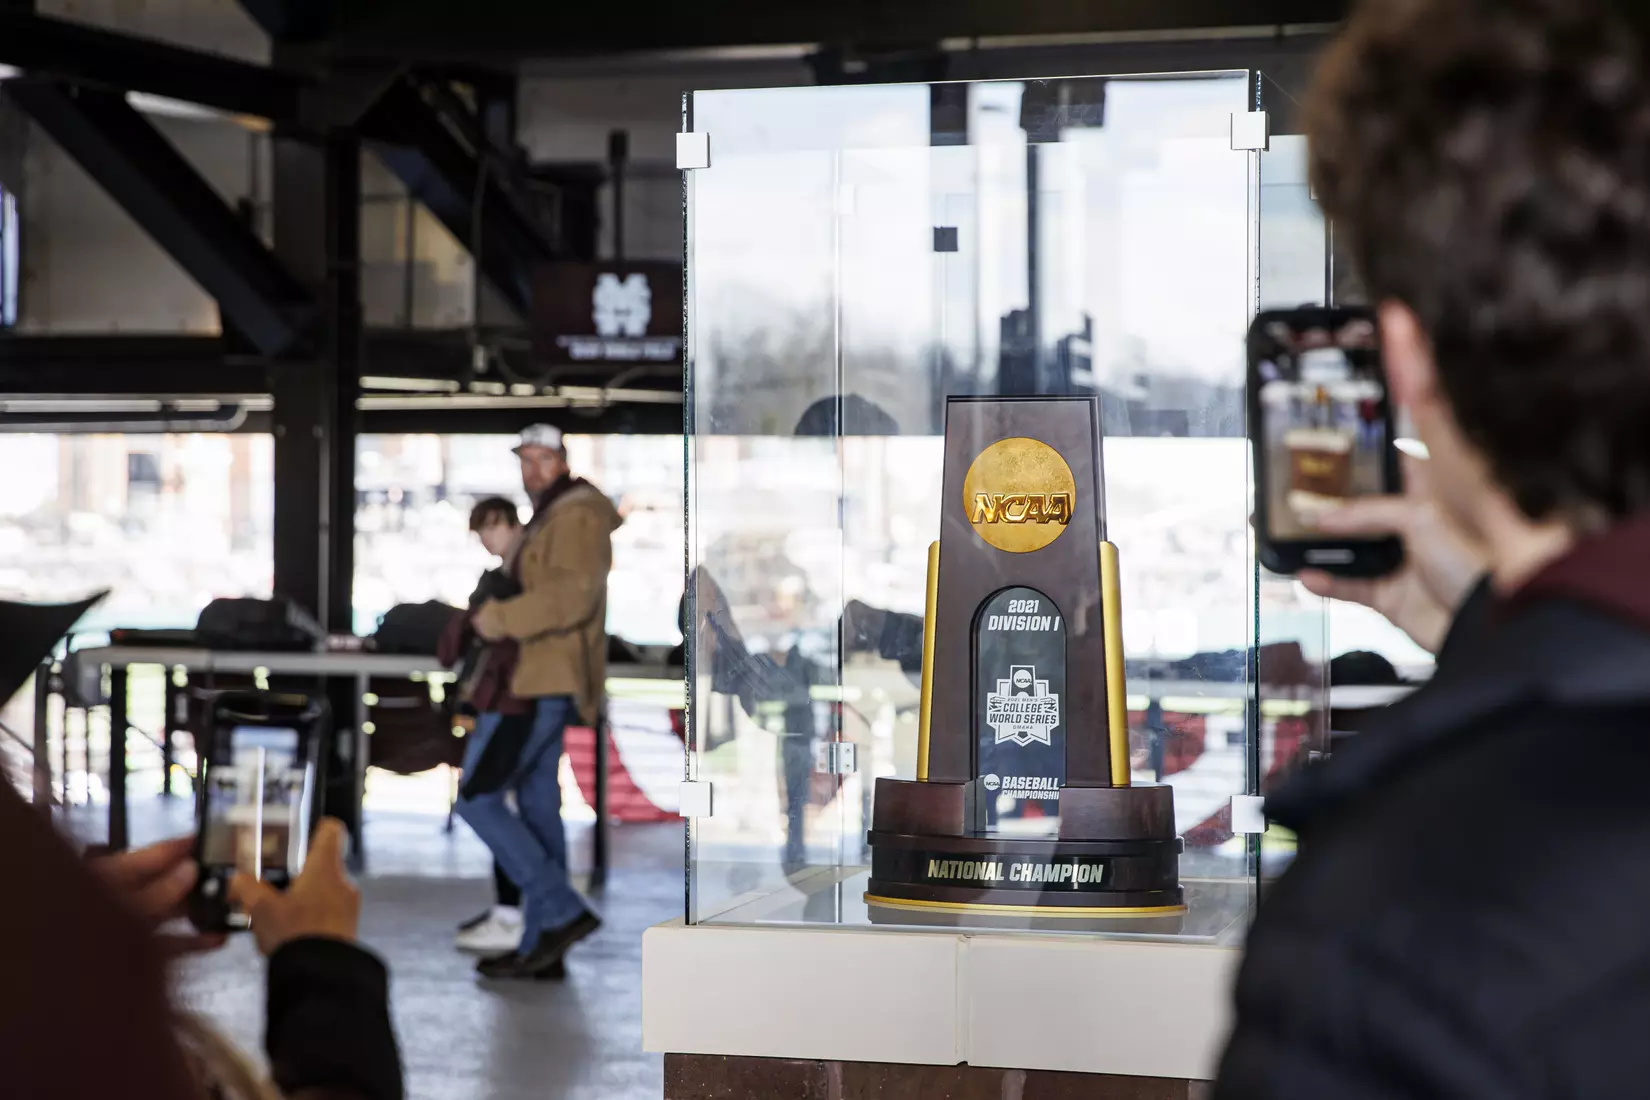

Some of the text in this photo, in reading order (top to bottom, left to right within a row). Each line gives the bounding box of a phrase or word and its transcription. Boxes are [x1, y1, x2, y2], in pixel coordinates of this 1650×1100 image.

[972, 493, 1072, 525] NCAA
[1008, 600, 1039, 614] 2021
[988, 615, 1060, 632] DIVISION I
[1003, 703, 1042, 713] COLLEGE
[989, 713, 1057, 725] WORLD SERIES
[1002, 776, 1060, 790] BASEBALL
[927, 859, 1104, 884] NATIONAL CHAMPION
